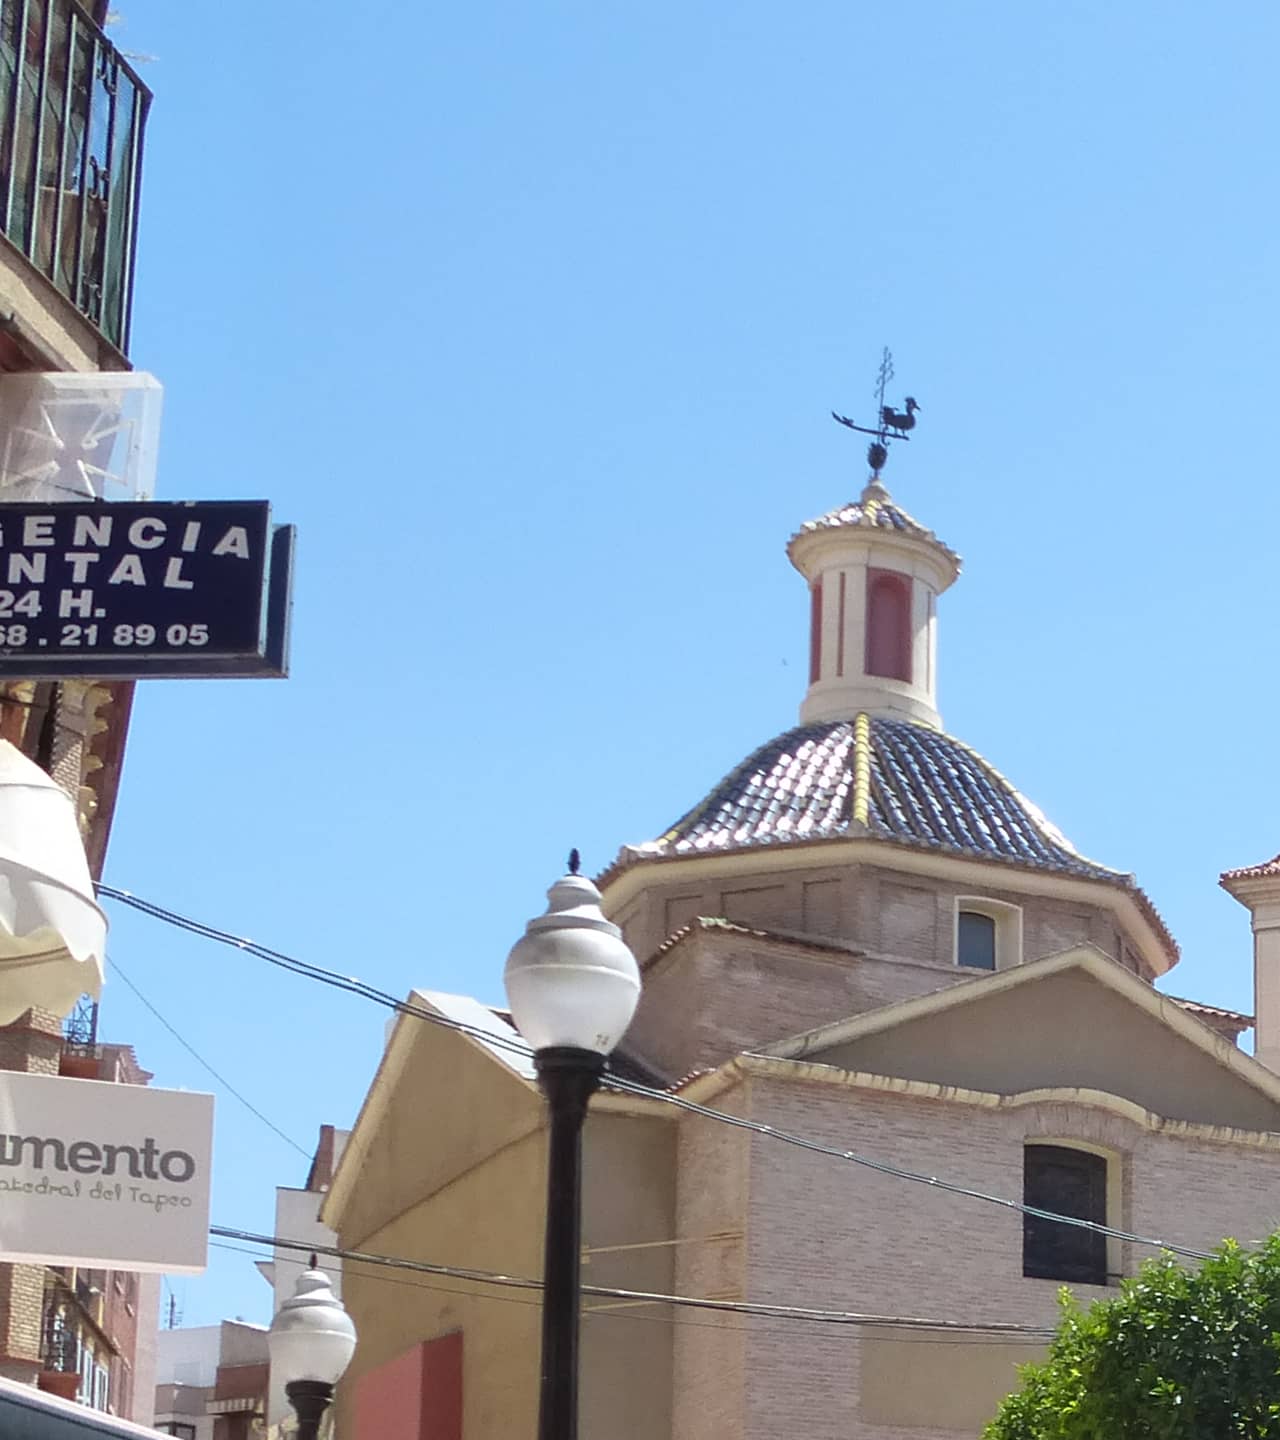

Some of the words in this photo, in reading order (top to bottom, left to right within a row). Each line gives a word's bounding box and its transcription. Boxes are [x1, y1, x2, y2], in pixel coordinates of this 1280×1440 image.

[0, 515, 250, 560] ENCIA
[59, 589, 106, 618] H.
[60, 624, 98, 646] 21
[113, 624, 156, 646] 89
[166, 624, 209, 646] 05
[89, 1181, 121, 1201] del
[129, 1186, 192, 1213] Tapeo
